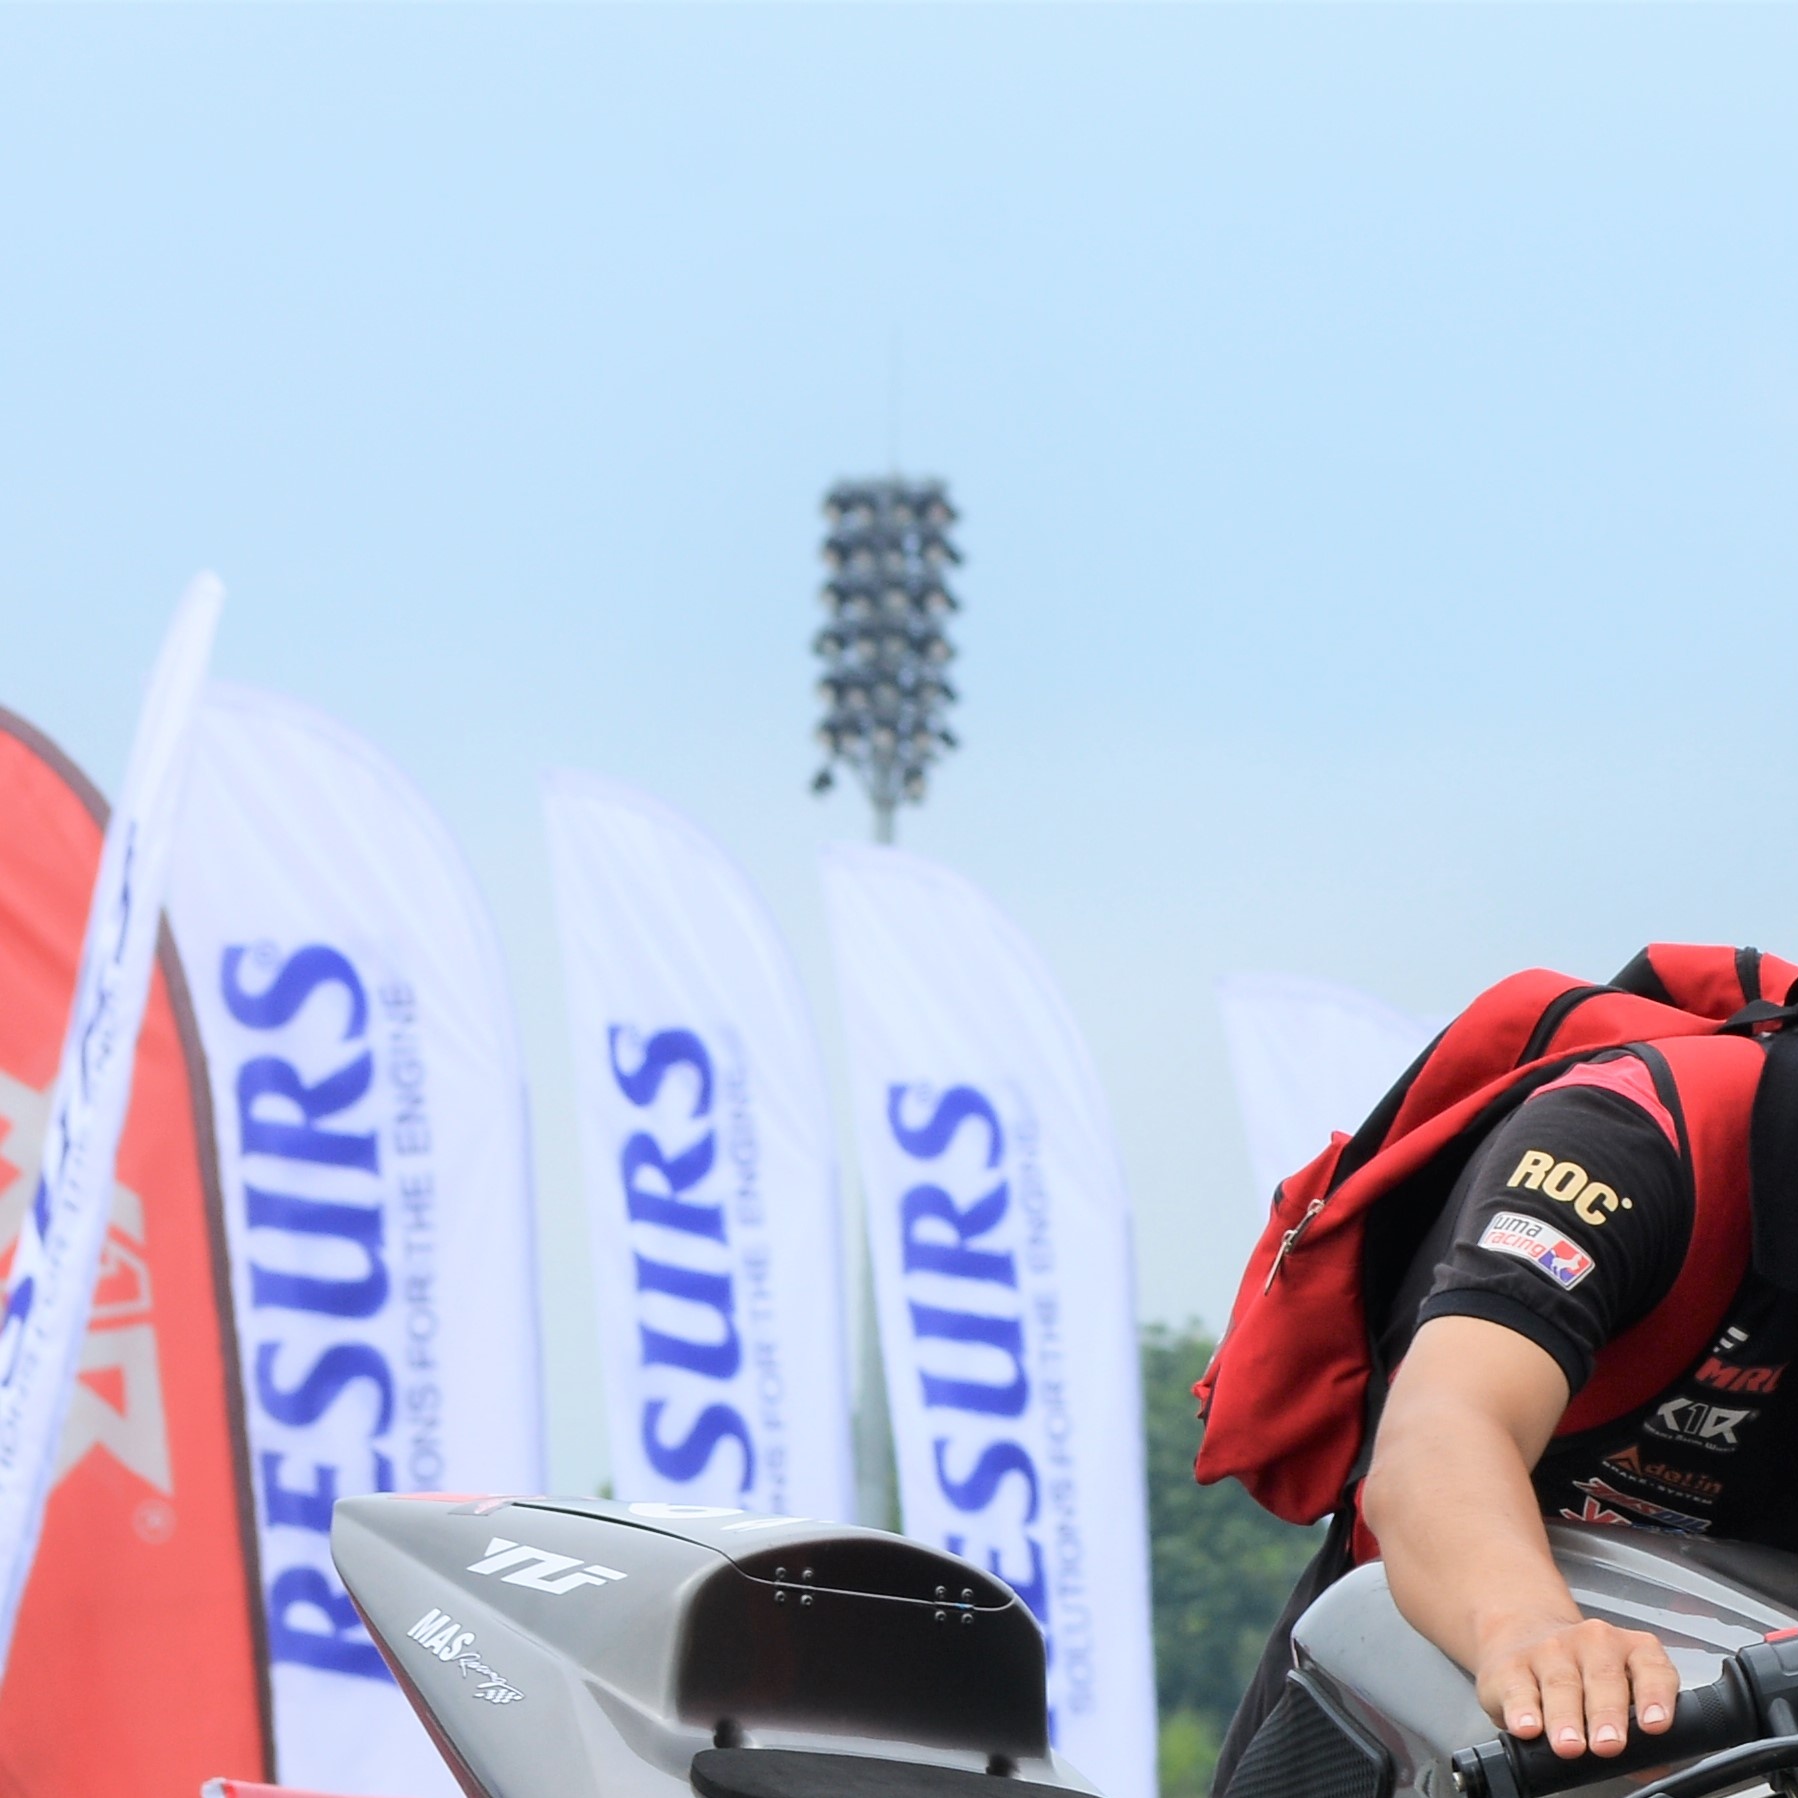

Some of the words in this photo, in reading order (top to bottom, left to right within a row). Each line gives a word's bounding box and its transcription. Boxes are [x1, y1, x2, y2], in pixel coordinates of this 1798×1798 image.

[1507, 1150, 1618, 1225] ROC
[610, 1023, 757, 1496] SURS
[1485, 1231, 1547, 1258] racing
[1494, 1217, 1542, 1237] uma
[220, 941, 400, 1690] RESURS
[886, 1082, 1052, 1690] ESURS
[407, 1607, 475, 1662] MAS
